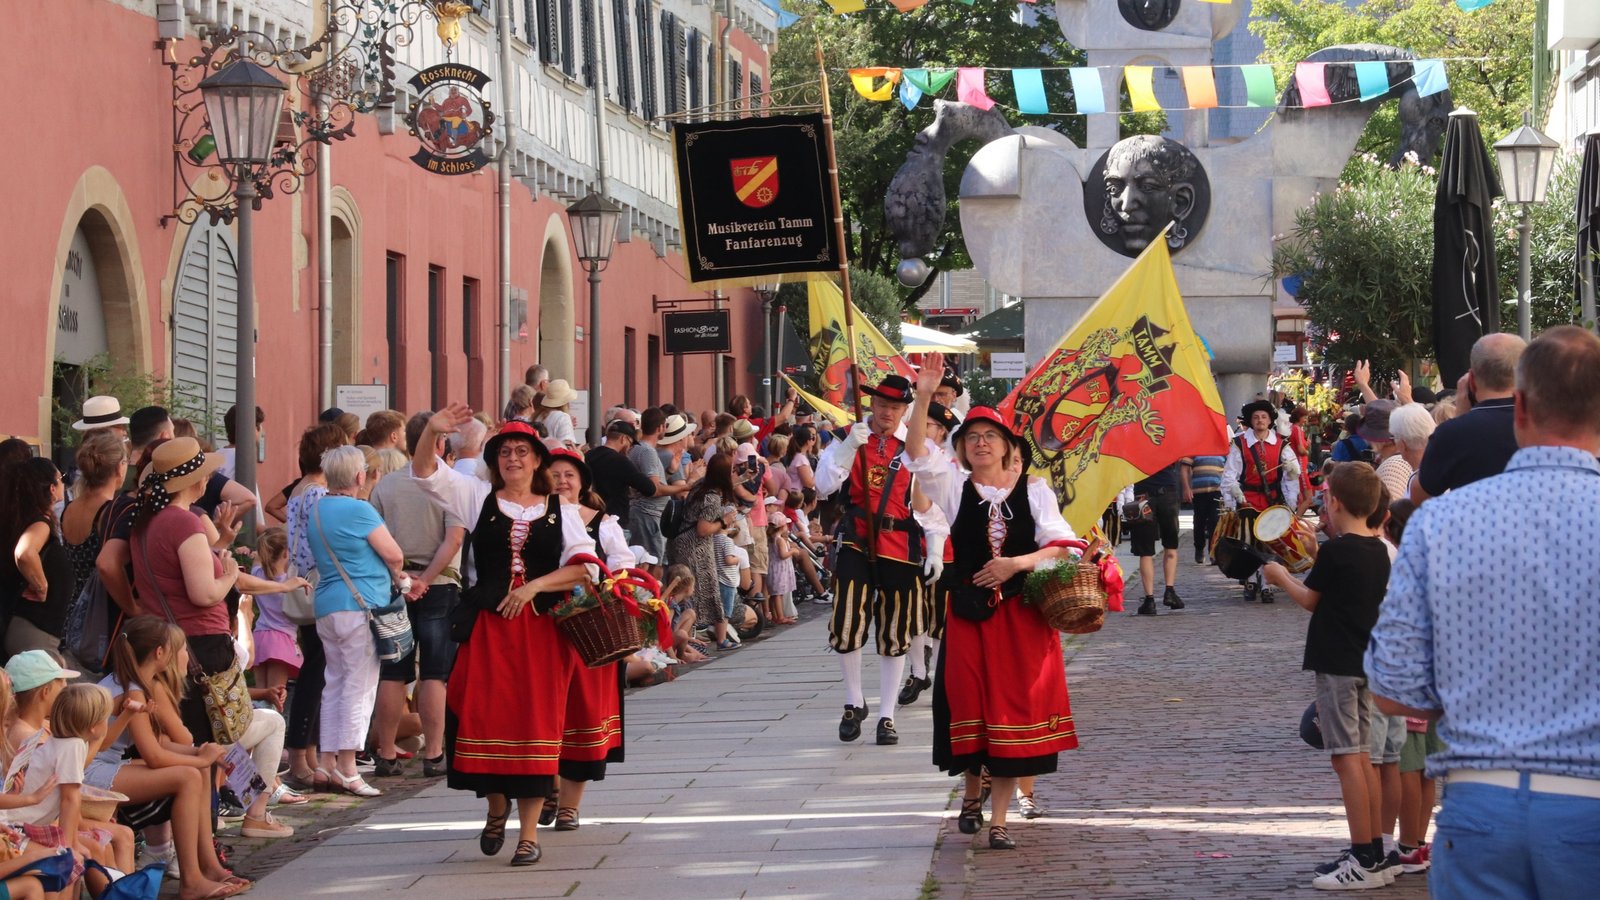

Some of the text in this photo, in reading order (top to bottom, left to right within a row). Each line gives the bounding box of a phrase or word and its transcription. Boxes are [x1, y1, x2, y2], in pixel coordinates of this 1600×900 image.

[440, 161, 476, 173] Schloss
[707, 217, 814, 235] Musikverein Tamm
[725, 234, 803, 251] Fanfarenzug
[1135, 327, 1163, 368] TAMM
